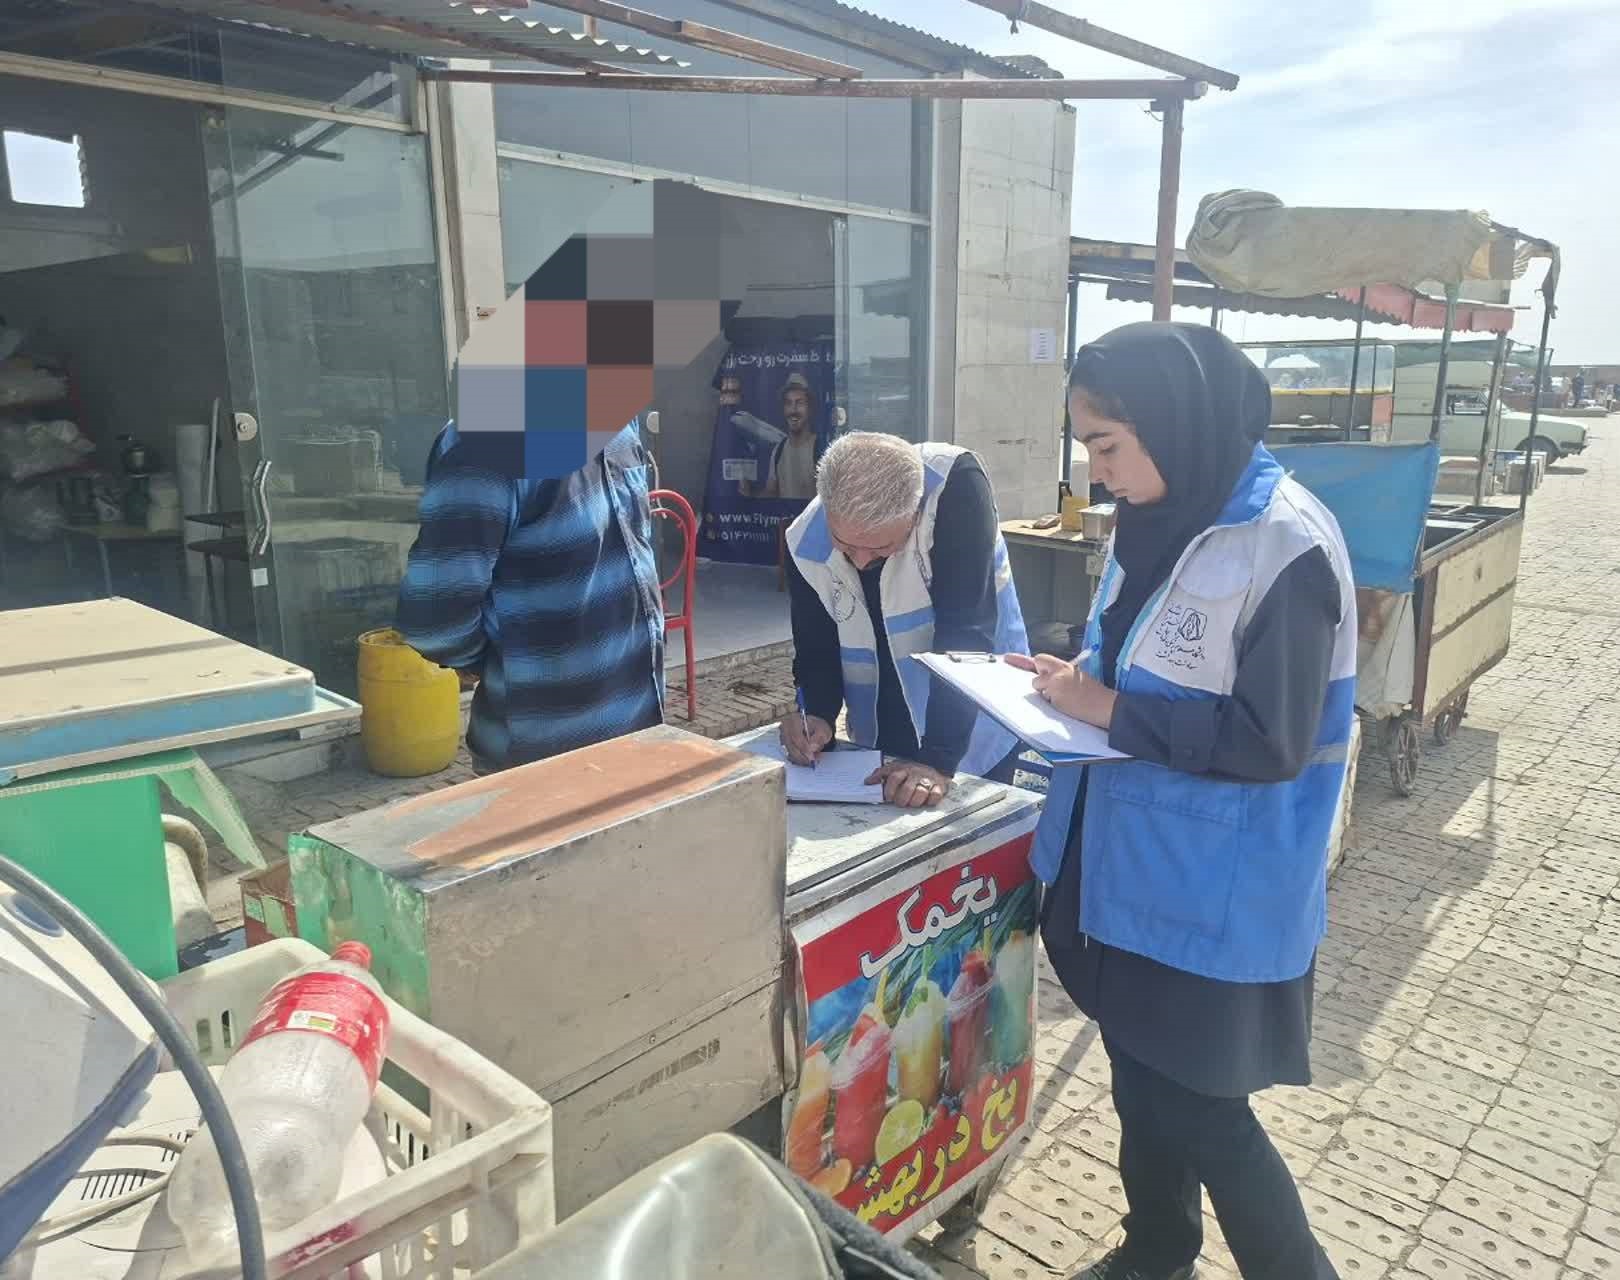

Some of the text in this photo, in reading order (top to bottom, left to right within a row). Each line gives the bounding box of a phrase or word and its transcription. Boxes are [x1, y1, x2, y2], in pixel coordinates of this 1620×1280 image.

[859, 864, 998, 980] یخمک
[855, 1077, 1017, 1225] یخ در بهش
